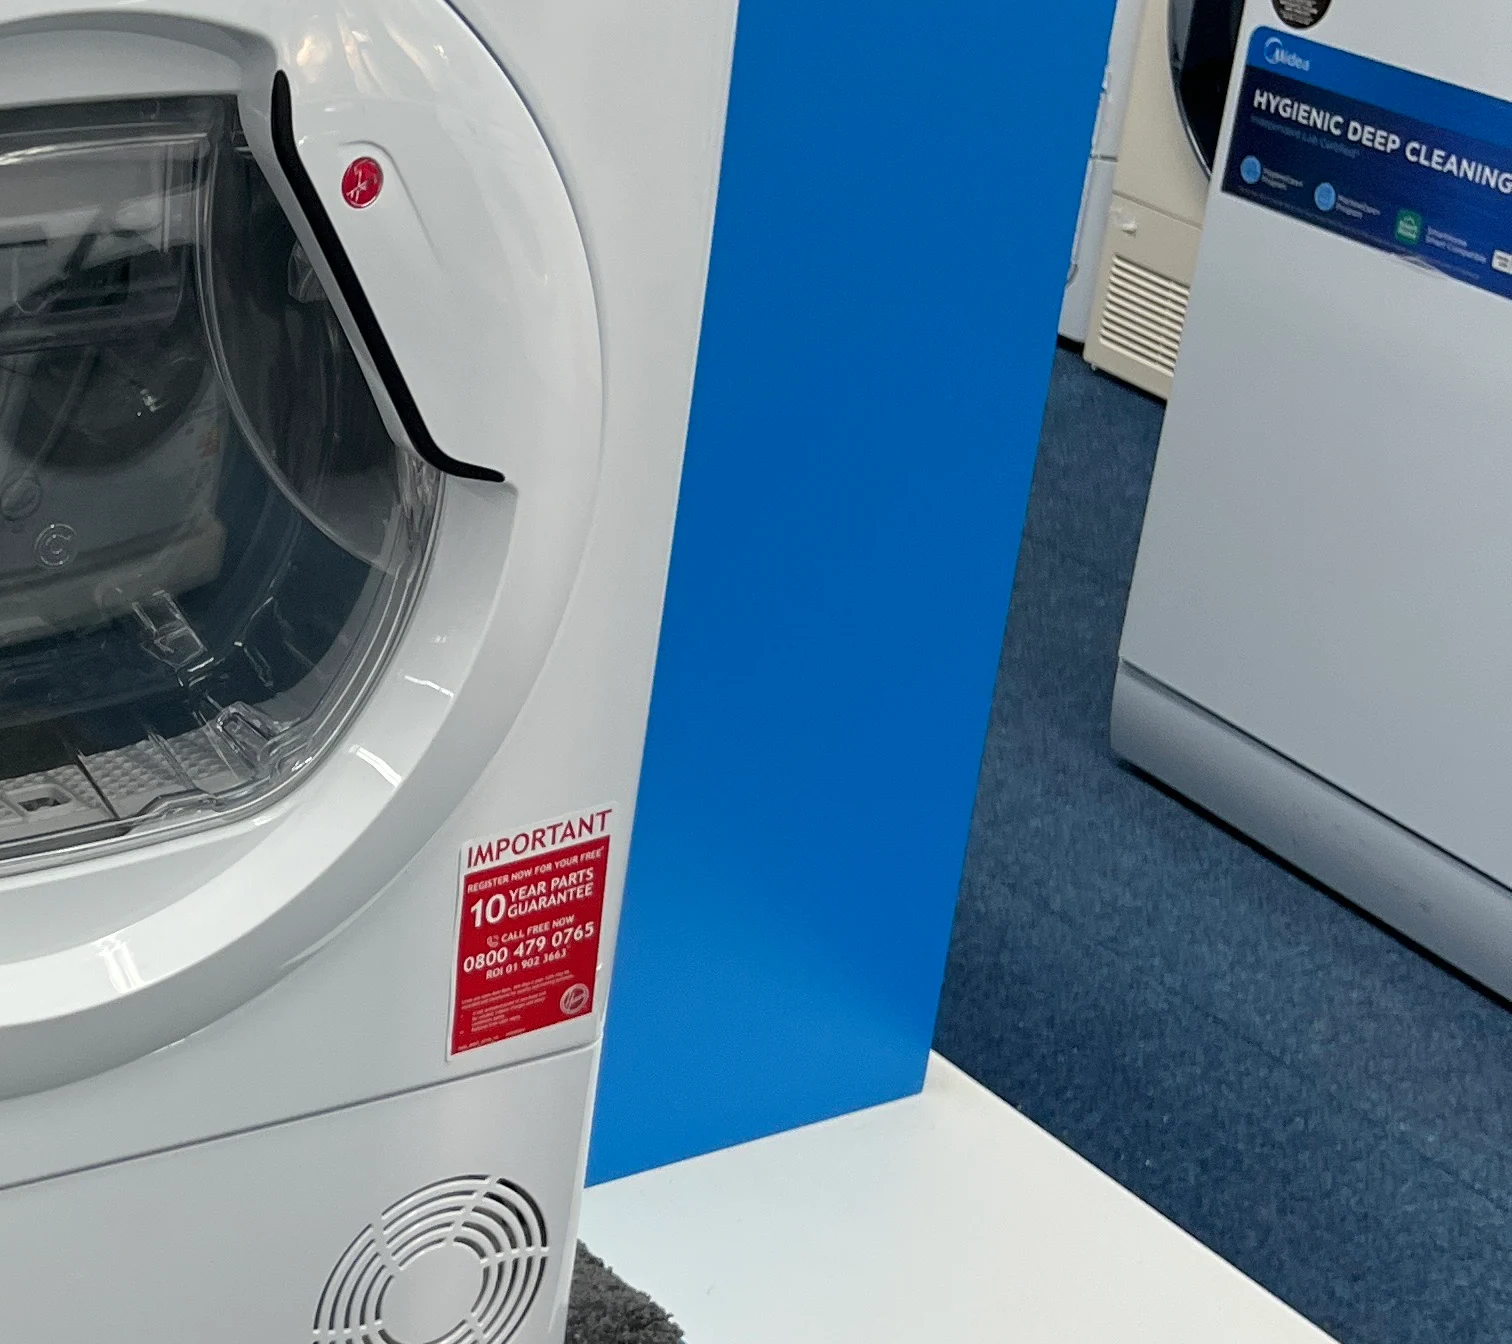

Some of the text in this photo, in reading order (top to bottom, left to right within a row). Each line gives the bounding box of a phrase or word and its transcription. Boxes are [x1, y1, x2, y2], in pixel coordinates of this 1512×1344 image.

[1253, 88, 1512, 194] HYGIENIC DEEP CLEANING
[466, 808, 613, 869] IMPORTANT
[467, 873, 510, 894] REGISTER
[510, 867, 533, 882] NOW
[534, 862, 553, 875] FOR
[554, 855, 579, 870] YOUR
[509, 866, 594, 902] YEAR PARTS
[469, 893, 507, 928] 10
[506, 882, 594, 918] GUARANTEE
[500, 914, 576, 943] CALL FREE NOW
[463, 921, 595, 973] 0800 479 0765
[485, 967, 504, 980] ROI
[505, 962, 518, 974] 01
[521, 957, 541, 969] 902
